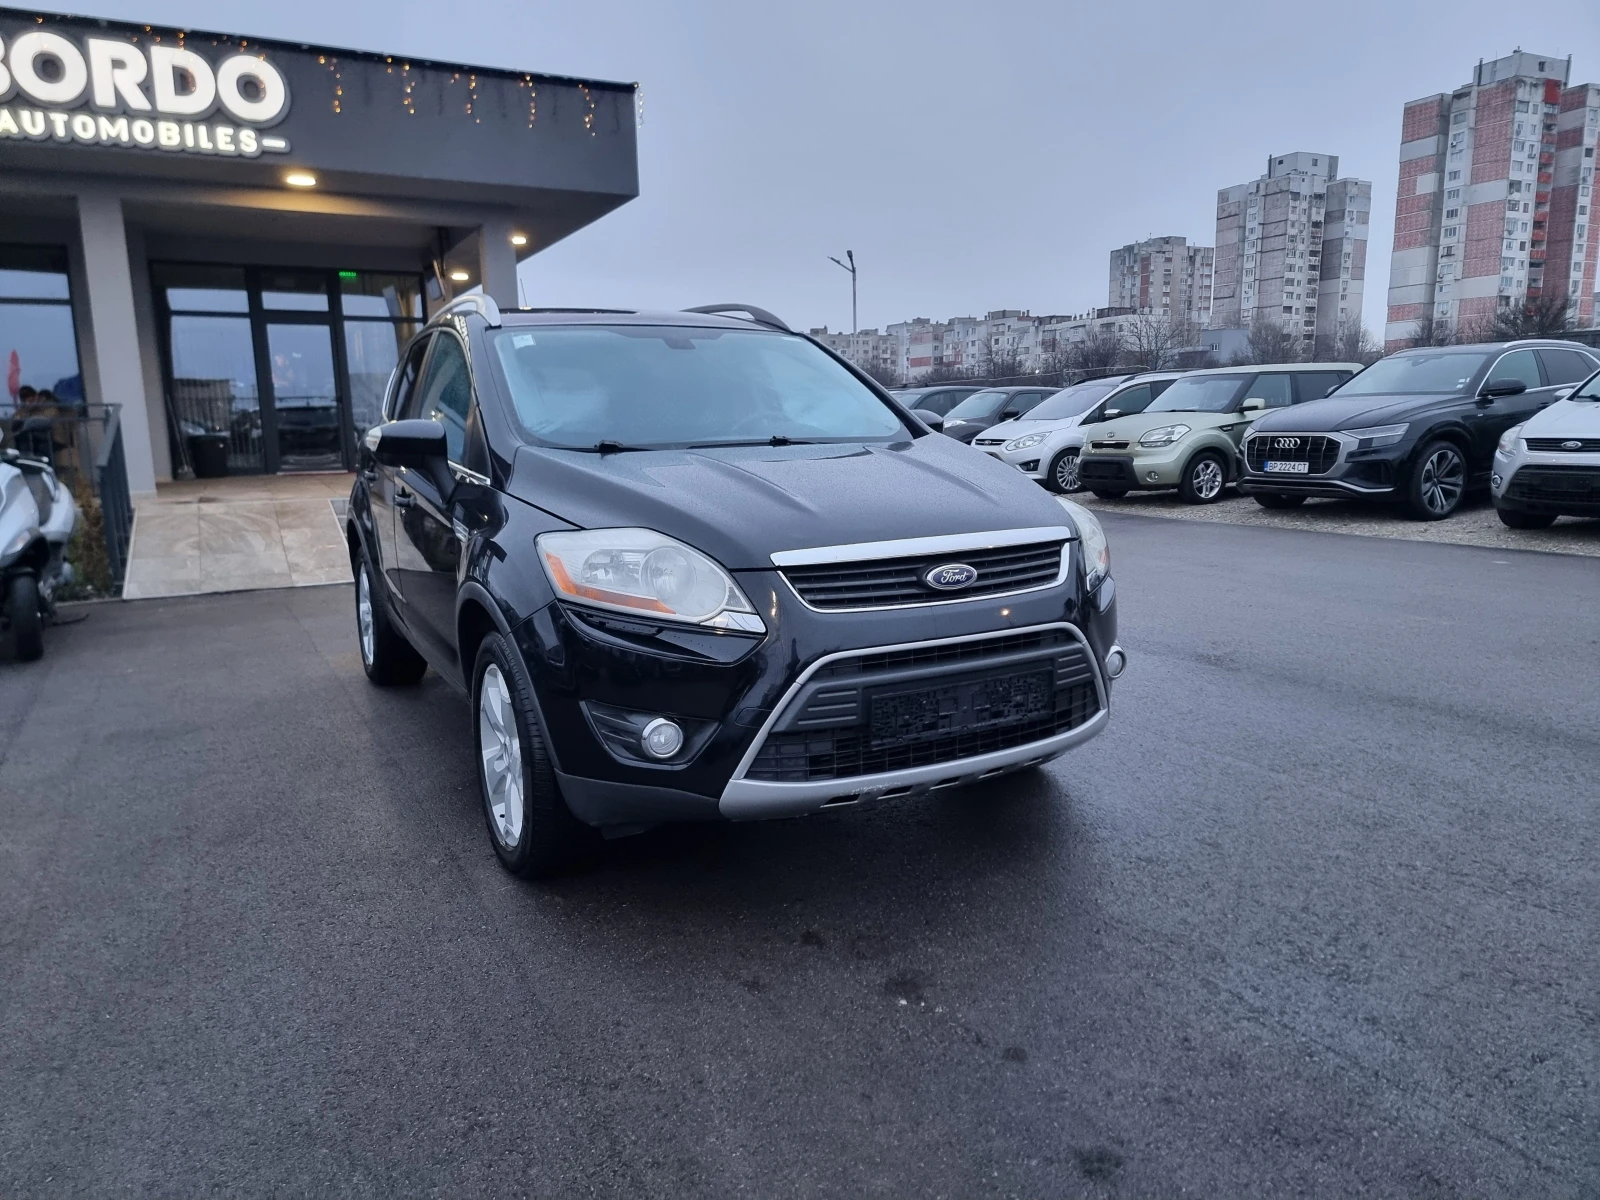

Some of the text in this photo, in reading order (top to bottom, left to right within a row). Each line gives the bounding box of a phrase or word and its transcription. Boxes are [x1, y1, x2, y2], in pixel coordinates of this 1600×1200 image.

[0, 31, 286, 122] ORDO
[0, 108, 259, 153] AUTOMOBILES
[1268, 462, 1308, 472] BP 2224 CT
[941, 569, 969, 584] Ford
